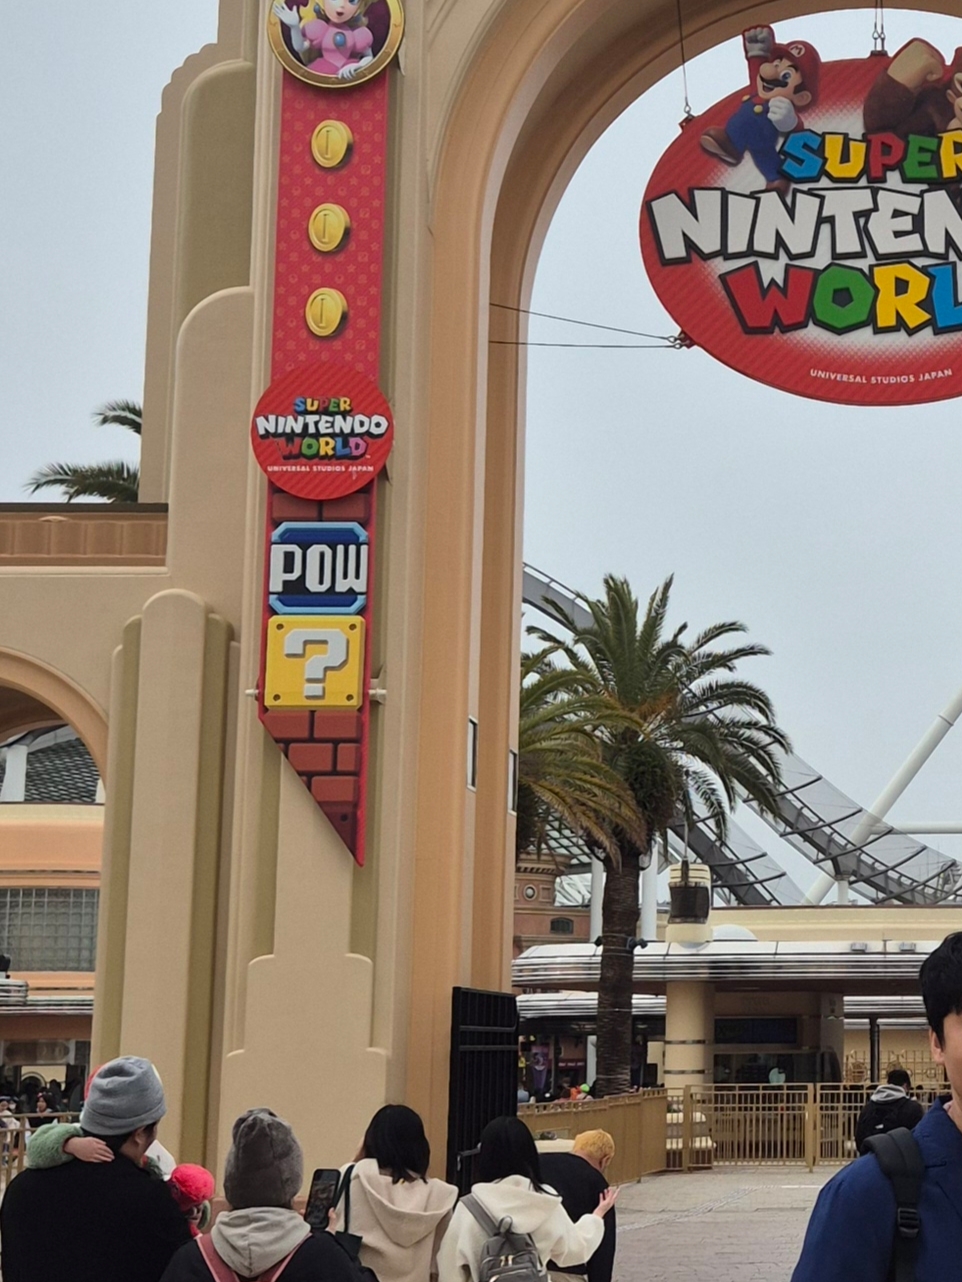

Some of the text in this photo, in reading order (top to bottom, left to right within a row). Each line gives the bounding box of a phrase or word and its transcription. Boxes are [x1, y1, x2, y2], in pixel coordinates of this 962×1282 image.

[810, 368, 953, 384] UNIVERSAL STUDIOS JAPAN
[294, 397, 352, 413] SUPER
[255, 414, 389, 436] NINTENDO
[275, 437, 368, 459] WORLD
[268, 544, 369, 593] POW
[283, 628, 350, 700] ?
